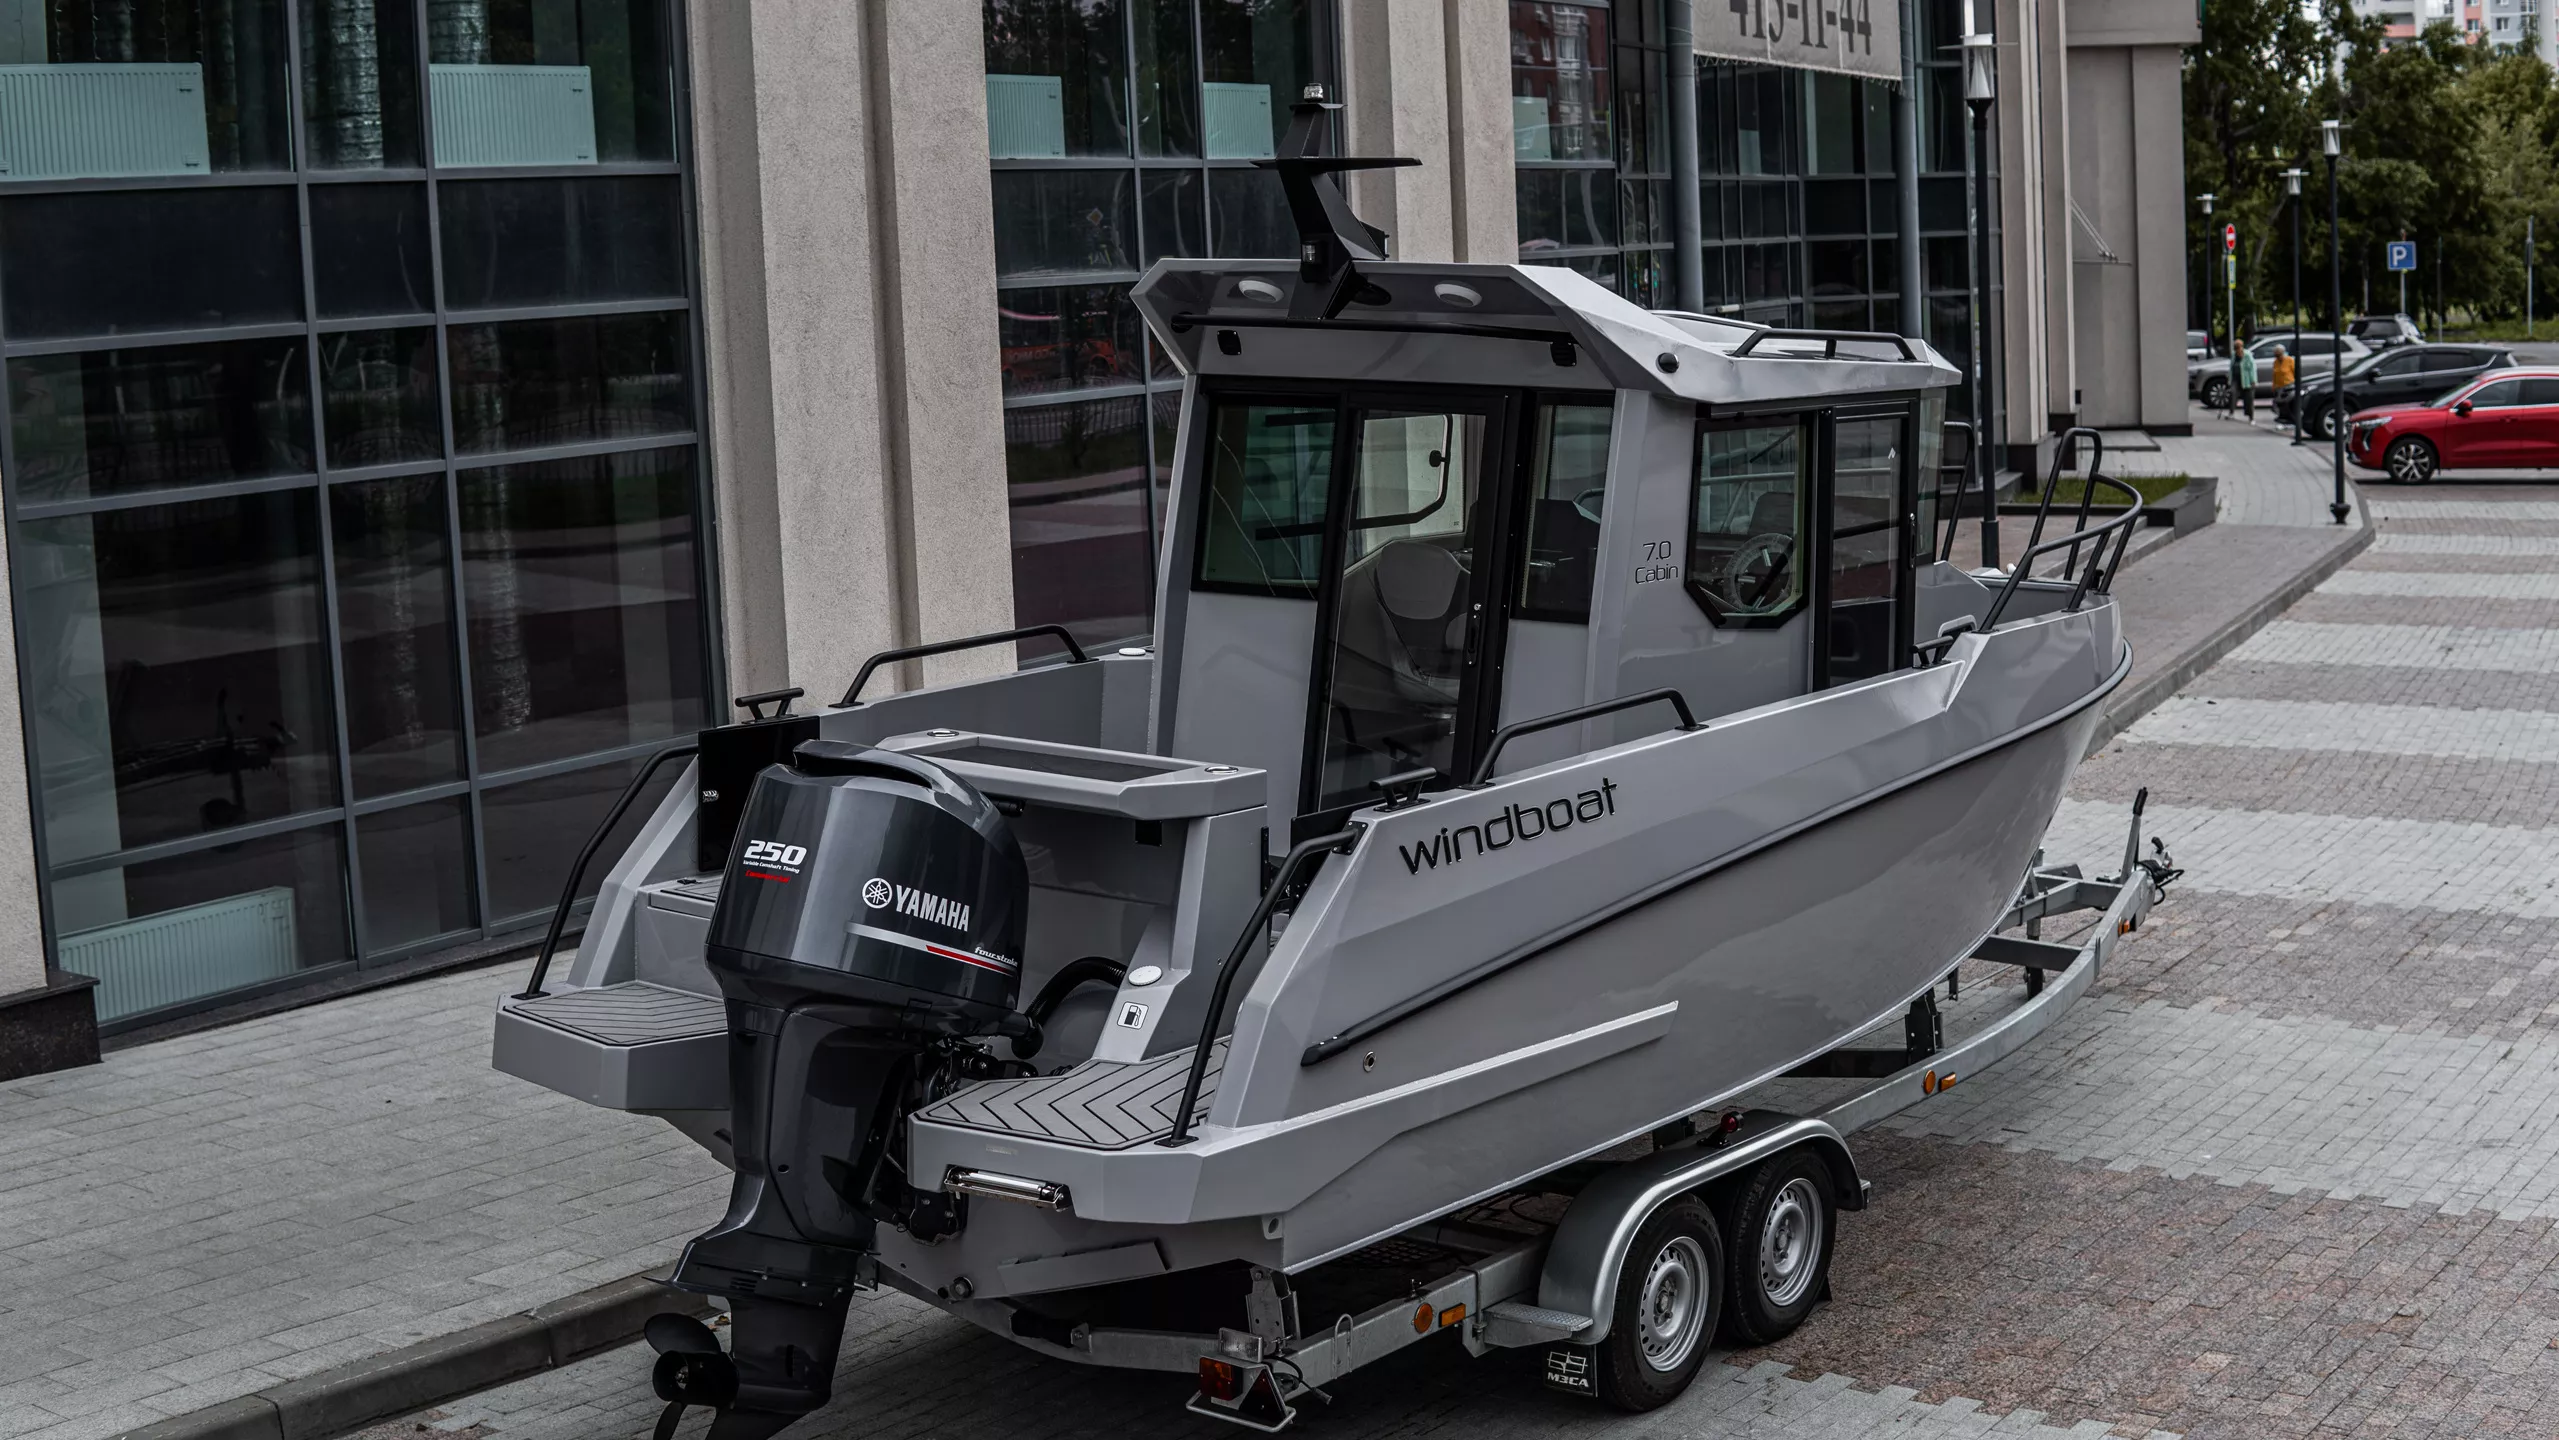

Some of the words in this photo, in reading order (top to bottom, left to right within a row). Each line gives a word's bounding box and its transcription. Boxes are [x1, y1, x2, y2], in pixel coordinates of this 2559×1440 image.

[2393, 246, 2407, 266] P
[1643, 540, 1672, 561] 7.0
[1635, 564, 1679, 584] Cabin
[1399, 777, 1618, 875] windboat
[743, 839, 808, 866] 250
[895, 884, 970, 932] YAMAHA
